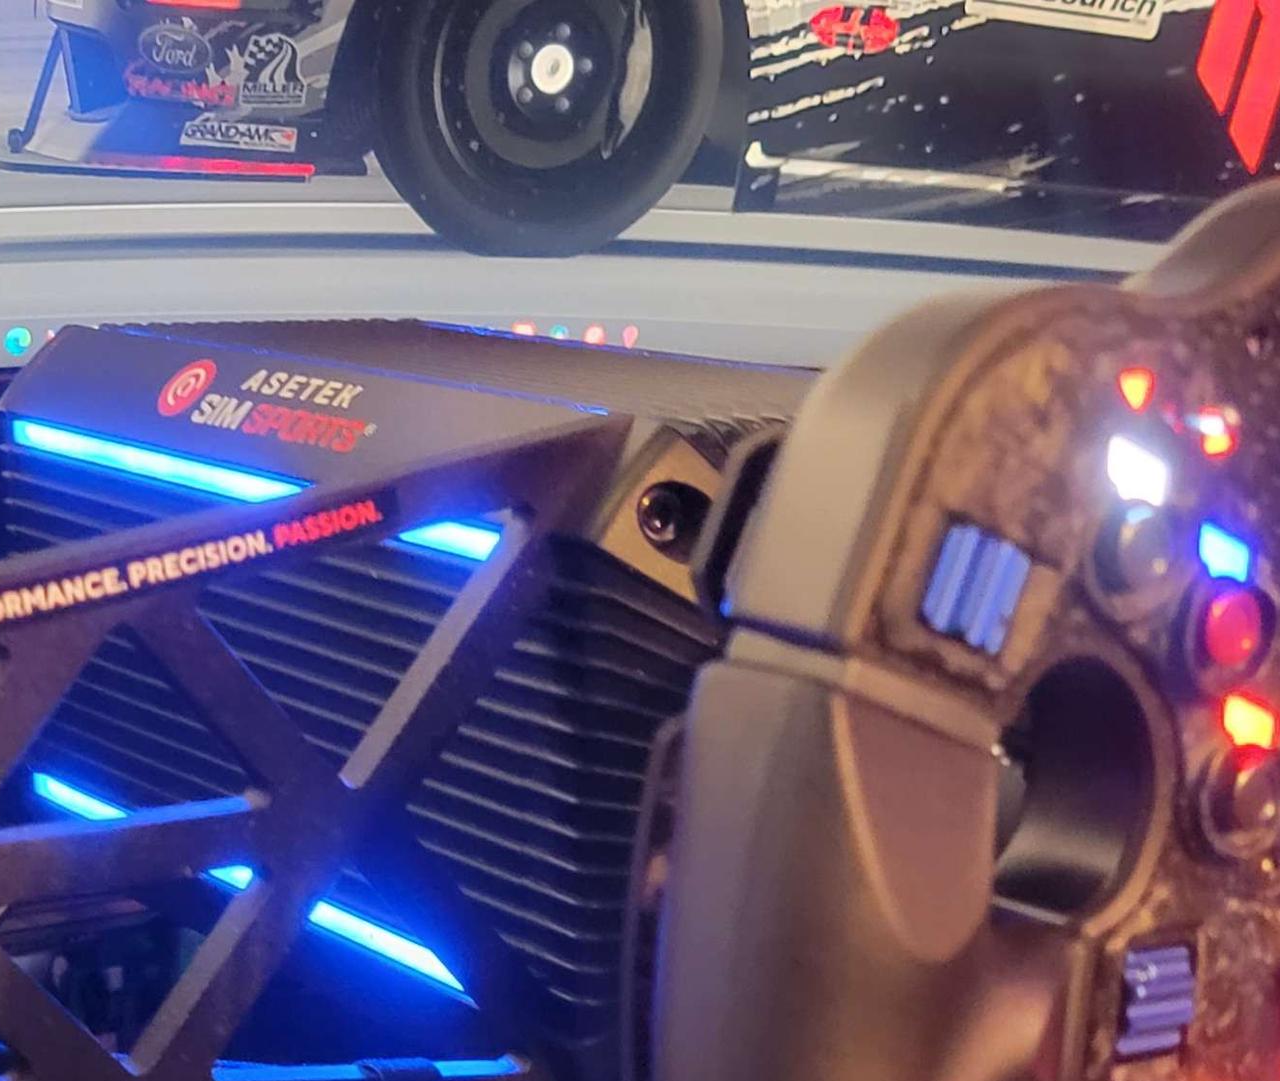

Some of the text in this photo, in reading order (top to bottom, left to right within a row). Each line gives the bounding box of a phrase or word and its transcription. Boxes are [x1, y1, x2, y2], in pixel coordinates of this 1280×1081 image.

[152, 31, 197, 67] Ford
[242, 81, 306, 97] MILLER
[240, 369, 364, 409] ASETEK
[126, 529, 274, 589] PRECISION.
[272, 499, 383, 549] PASSION.
